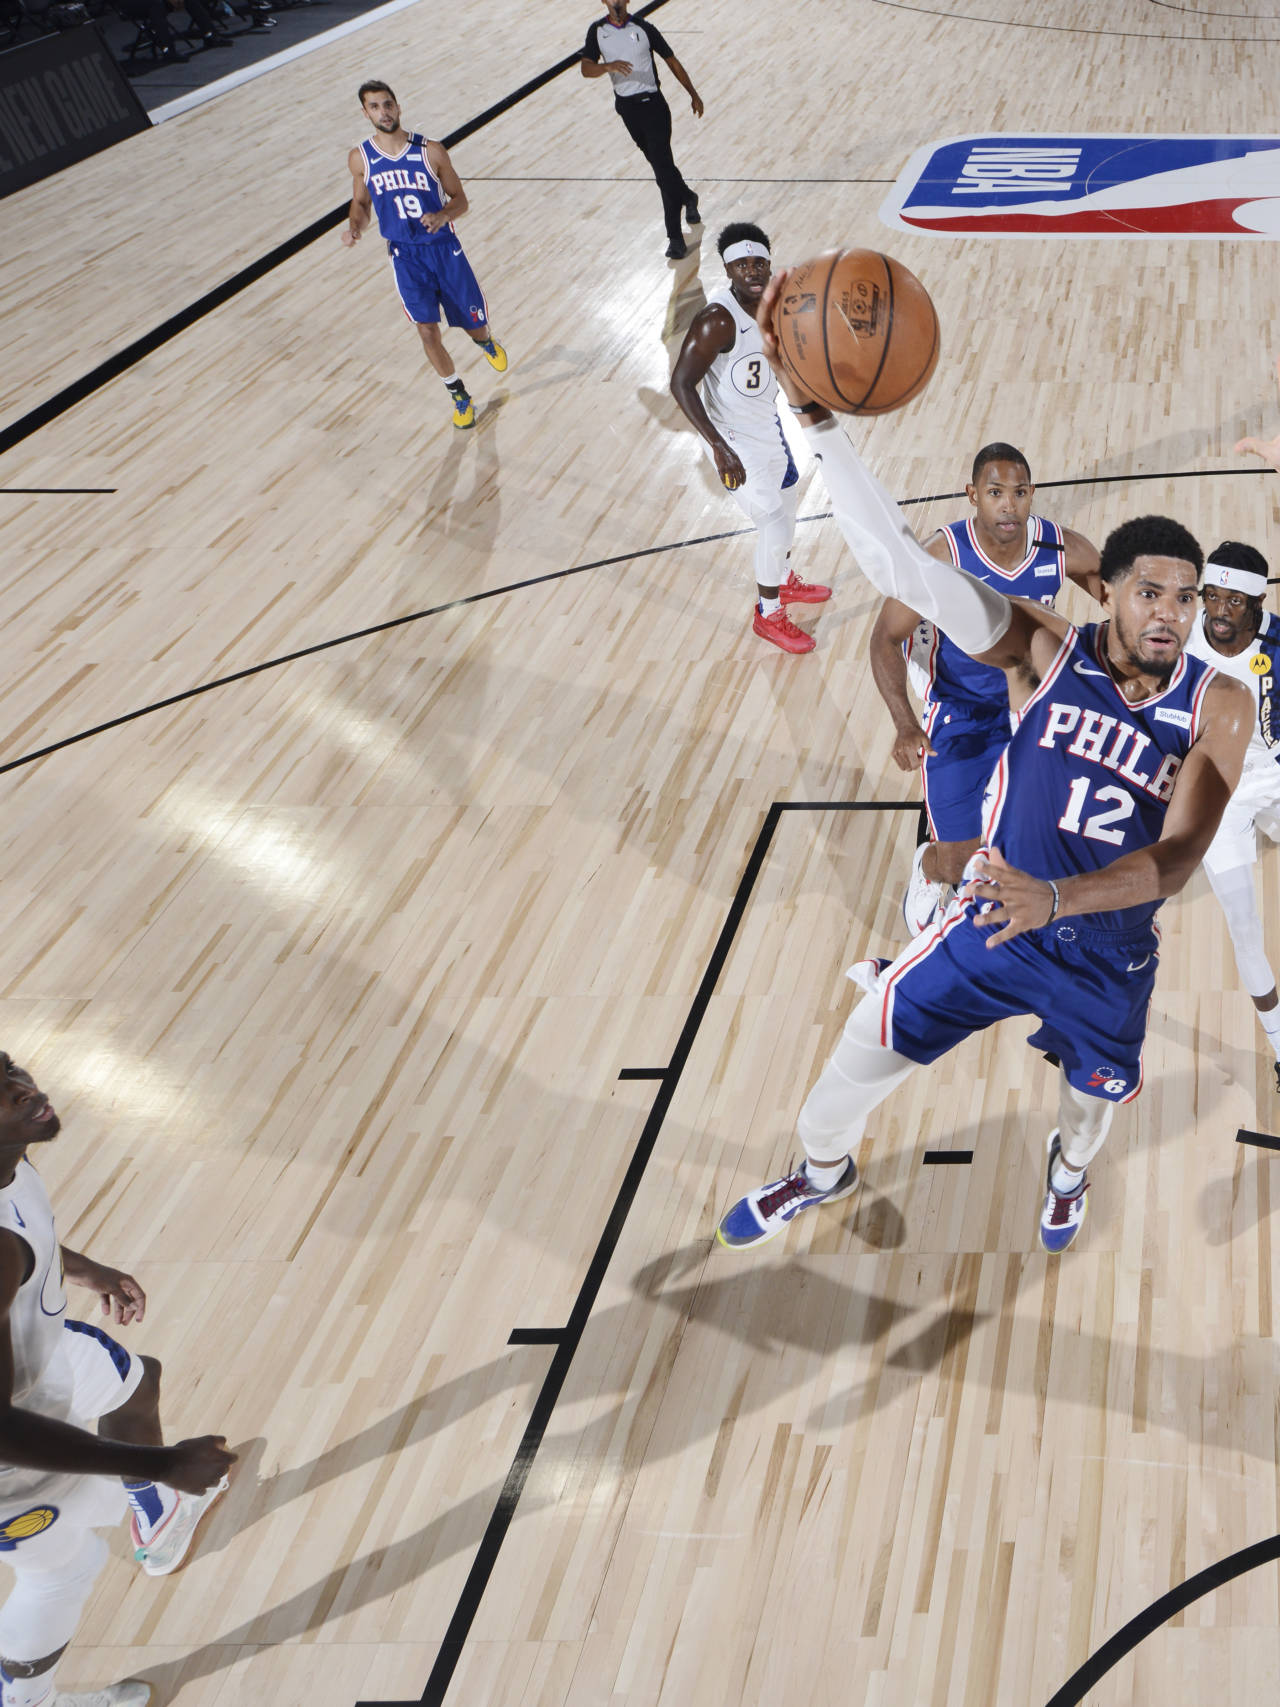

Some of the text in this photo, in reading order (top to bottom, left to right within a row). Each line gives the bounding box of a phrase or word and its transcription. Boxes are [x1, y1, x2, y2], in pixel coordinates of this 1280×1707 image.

[370, 169, 431, 195] PHILA
[951, 147, 1082, 194] NBA
[393, 195, 423, 219] 19
[746, 361, 761, 389] 3
[1159, 710, 1187, 723] StubHub
[1038, 703, 1182, 802] PHILA
[1058, 776, 1136, 846] 12
[1087, 1072, 1127, 1094] 76
